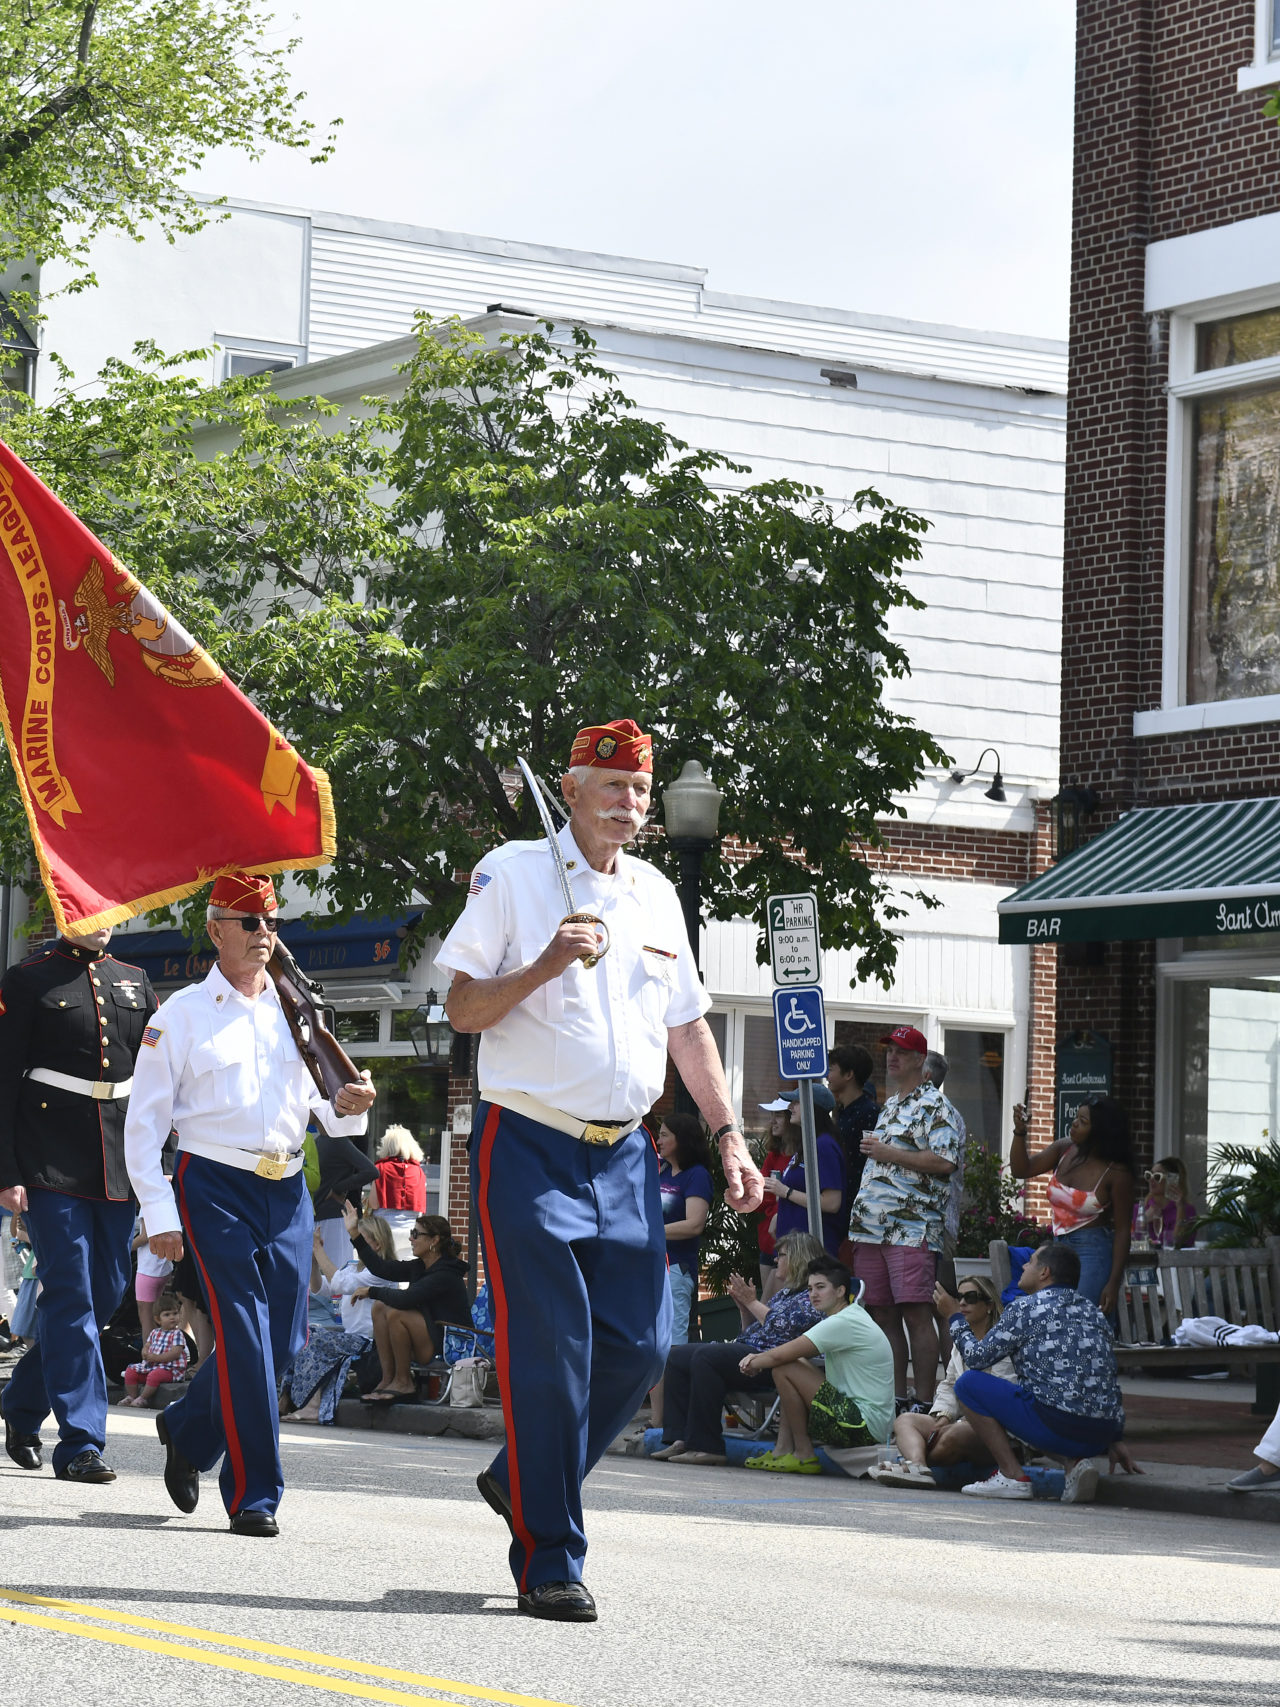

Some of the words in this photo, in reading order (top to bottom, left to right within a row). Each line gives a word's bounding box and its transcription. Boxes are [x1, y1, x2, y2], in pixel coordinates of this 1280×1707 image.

[26, 699, 62, 805] MARINE
[773, 906, 784, 927] 2
[793, 903, 804, 914] HR
[785, 915, 812, 928] PARKING
[1216, 903, 1253, 931] Sant
[1026, 917, 1061, 937] BAR
[778, 935, 794, 944] 9:00
[372, 939, 391, 962] 36
[791, 945, 799, 953] to
[780, 955, 796, 964] 6:00
[797, 956, 812, 965] p.m.
[163, 958, 180, 977] Le
[782, 1036, 822, 1048] HANDICAPPED
[790, 1049, 815, 1060] PARKING
[796, 1060, 811, 1071] ONLY
